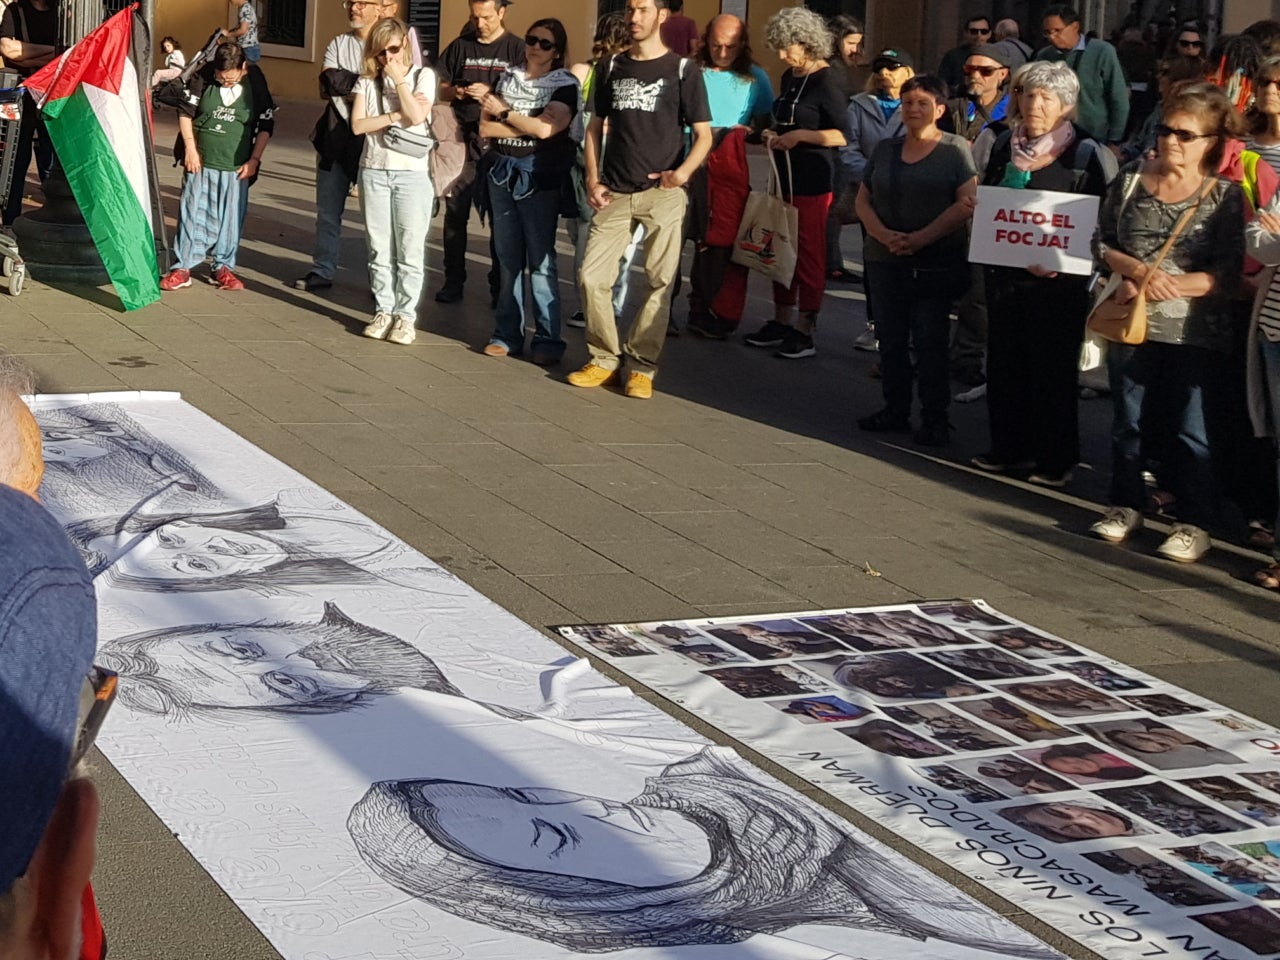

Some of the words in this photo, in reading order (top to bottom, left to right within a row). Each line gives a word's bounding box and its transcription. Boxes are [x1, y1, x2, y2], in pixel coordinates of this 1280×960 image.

[993, 208, 1047, 226] ALTO
[1051, 214, 1076, 230] EL
[995, 229, 1034, 246] FOC
[1037, 234, 1070, 250] JA!
[798, 751, 952, 828] DUERMAN
[907, 785, 1151, 917] MASACRADOS
[954, 838, 1073, 900] NIÑOS
[1078, 910, 1169, 958] LOS
